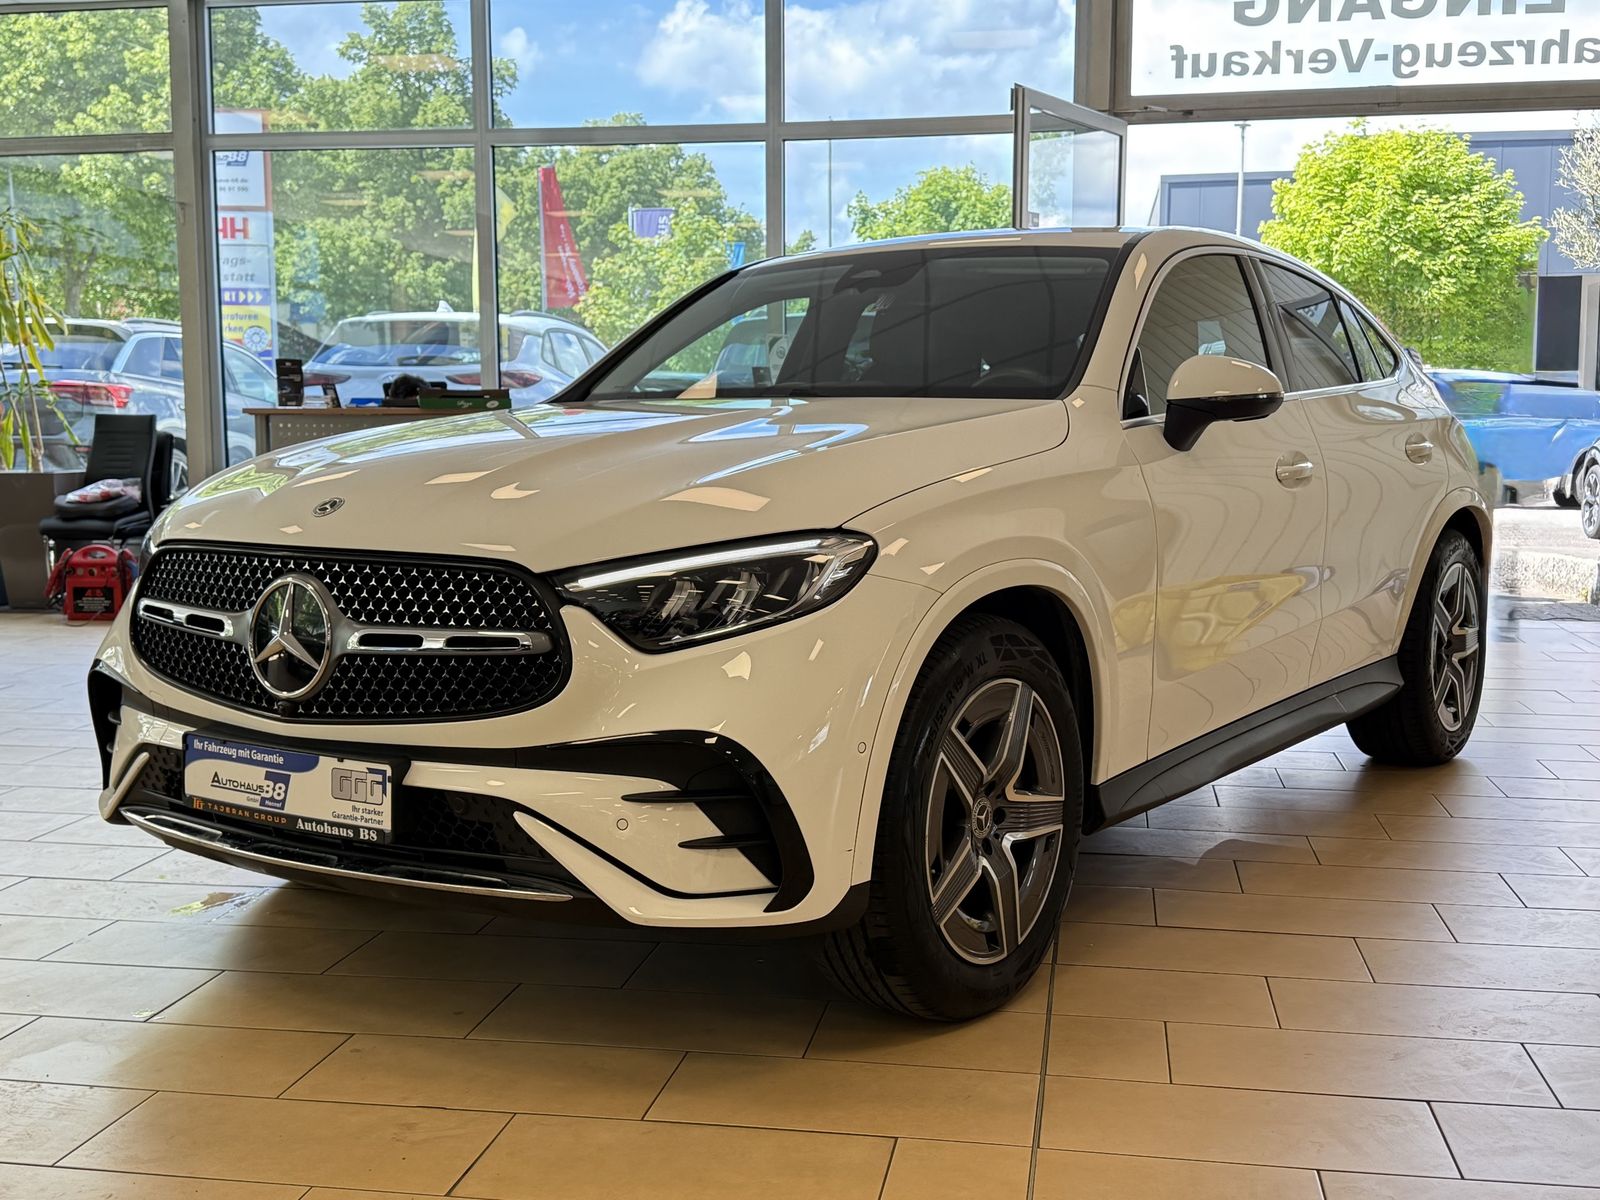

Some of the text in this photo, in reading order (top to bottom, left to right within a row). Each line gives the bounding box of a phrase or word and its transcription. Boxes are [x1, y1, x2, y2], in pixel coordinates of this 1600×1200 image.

[194, 739, 285, 765] Ihr Fahrzeug mit Garantie
[254, 812, 287, 824] GROUP
[332, 810, 384, 826] Garantie-Partner
[351, 805, 384, 817] Ihr starker
[296, 818, 377, 842] Autohaus B8
